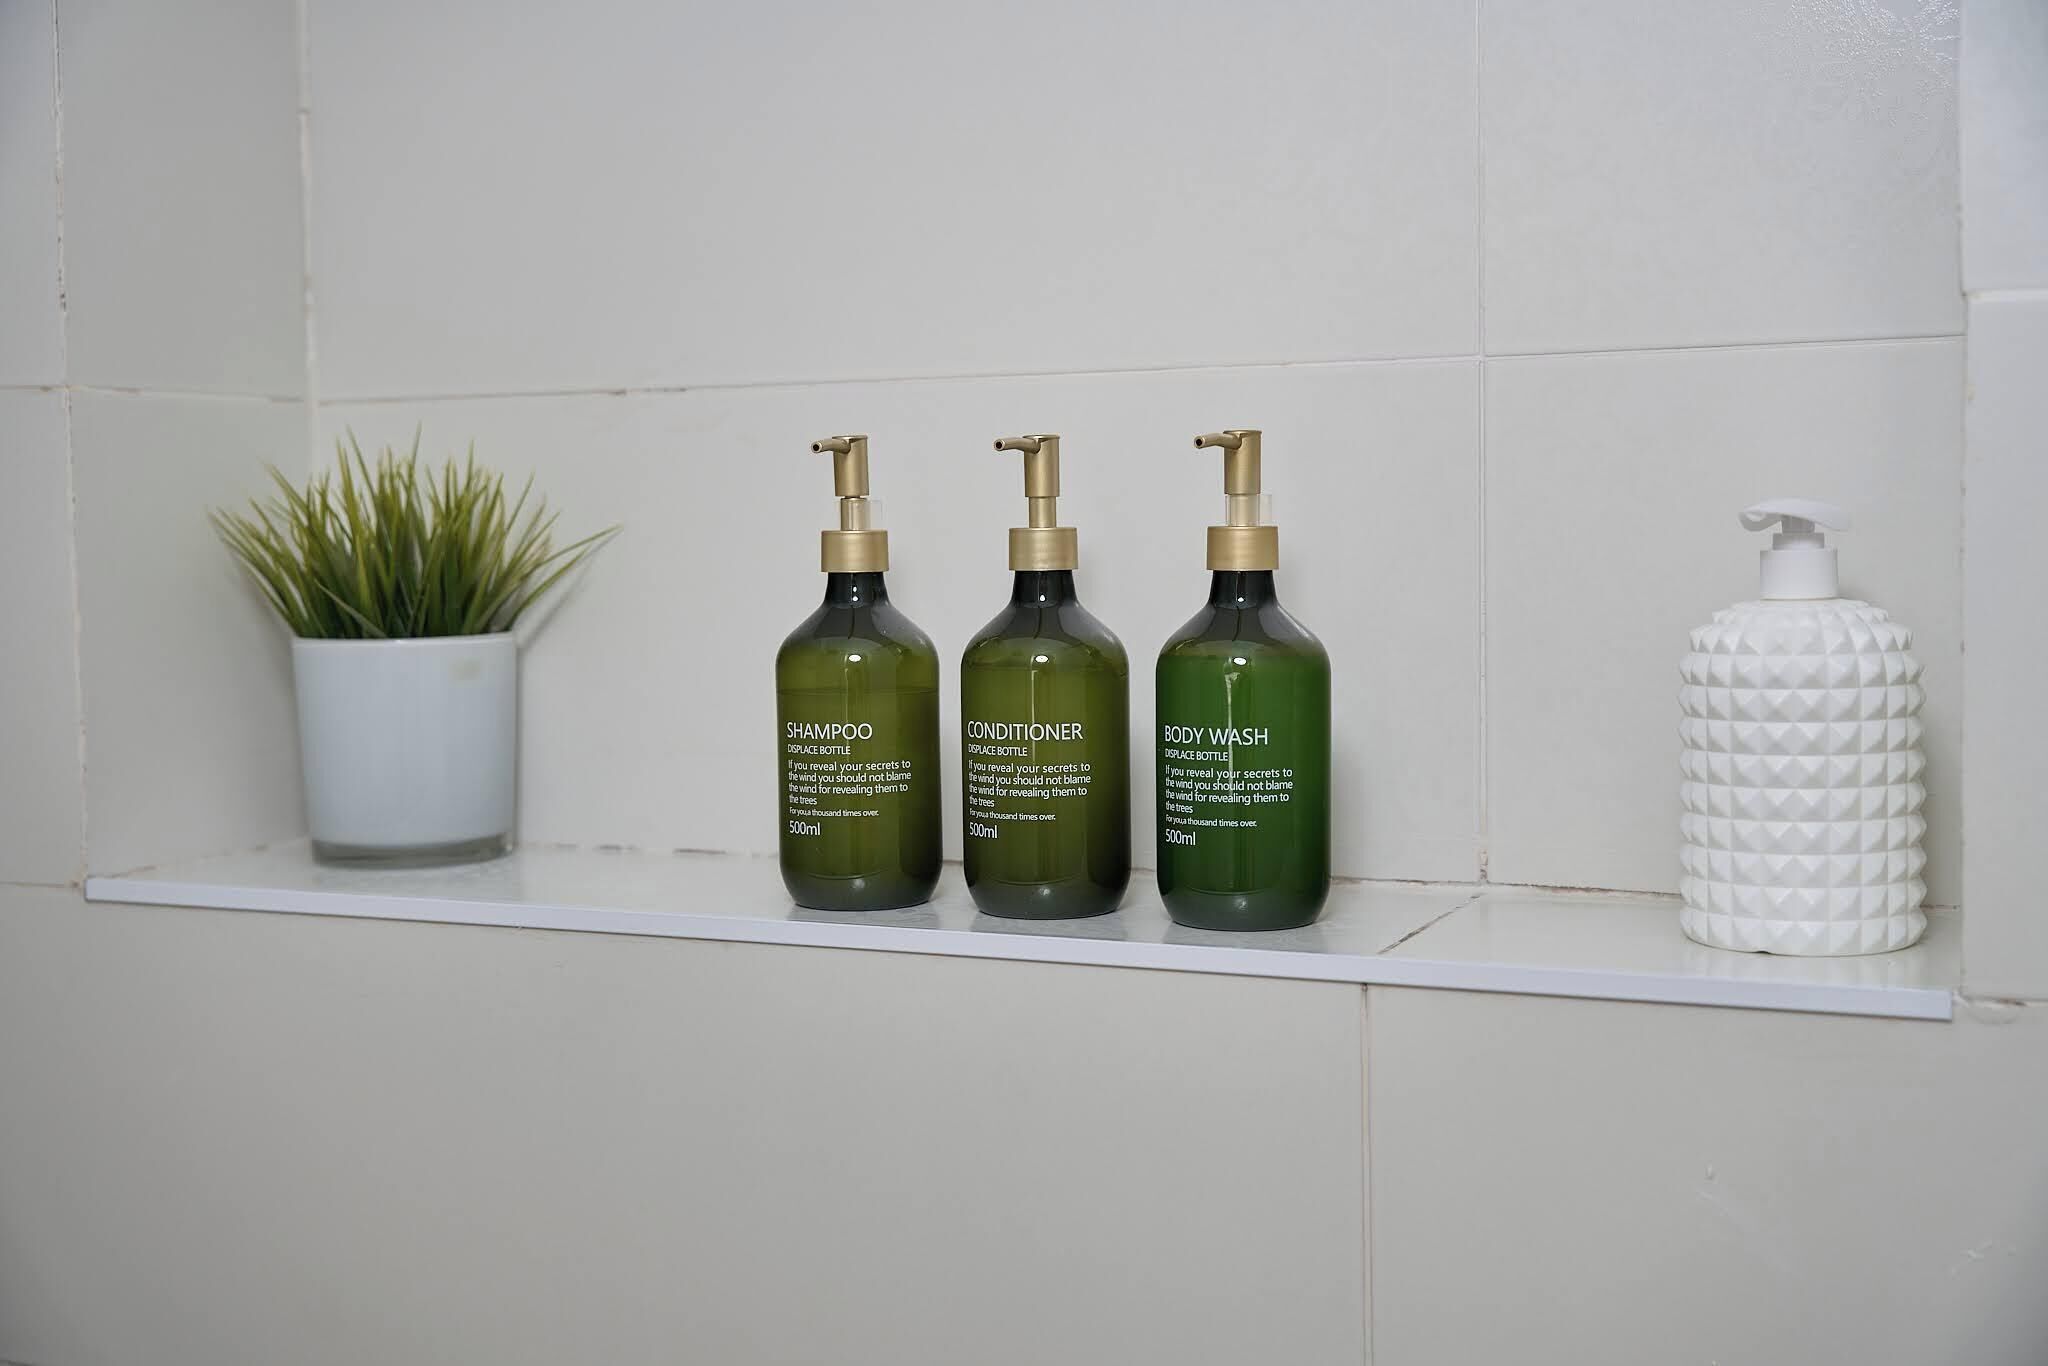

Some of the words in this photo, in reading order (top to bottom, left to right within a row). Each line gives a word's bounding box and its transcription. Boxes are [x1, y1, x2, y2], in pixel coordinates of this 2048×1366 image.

[787, 722, 873, 740] SHAMPOO
[968, 721, 1083, 740] CONDITIONER
[1165, 725, 1204, 745] BODY
[1209, 728, 1268, 745] WASH
[788, 744, 817, 754] DISPLACE
[820, 746, 851, 755] BOTTLE
[968, 744, 996, 755] DISPLACE
[998, 746, 1027, 756] BOTTLE
[1165, 749, 1194, 760] DISPLACE
[1197, 751, 1228, 761] BOTTLE
[788, 760, 793, 768] If
[794, 762, 807, 771] you
[810, 762, 836, 771] reveal
[840, 764, 863, 773] your
[866, 761, 899, 771] secrets
[902, 760, 910, 768] to
[969, 760, 973, 768] If
[974, 762, 986, 772] you
[988, 763, 1013, 772] reveal
[1017, 766, 1039, 775] your
[1043, 763, 1077, 773] secrets
[1081, 763, 1090, 771] to
[1166, 765, 1170, 774] If
[1171, 767, 1184, 777] you
[1187, 768, 1213, 778] reveal
[1217, 771, 1240, 780] your
[1244, 769, 1279, 778] secrets
[1283, 768, 1292, 777] to
[789, 772, 799, 781] the
[799, 773, 816, 782] wind
[818, 775, 834, 784] you
[836, 773, 866, 782] should
[886, 772, 911, 781] blame
[969, 772, 978, 781] the
[978, 774, 994, 783] wind
[996, 776, 1011, 786] you
[1013, 775, 1043, 785] should
[1046, 776, 1062, 784] not
[1064, 775, 1091, 784] blame
[1166, 777, 1176, 787] the
[1176, 779, 1192, 788] wind
[1194, 781, 1210, 791] you
[1213, 780, 1244, 790] should
[1247, 782, 1264, 790] not
[1266, 780, 1293, 790] blame
[789, 783, 799, 792] the
[799, 784, 816, 793] wind
[819, 784, 830, 794] for
[833, 785, 873, 796] revealing
[875, 784, 897, 793] them
[969, 783, 979, 793] the
[979, 785, 994, 796] wind
[996, 787, 1008, 796] for
[1010, 787, 1049, 799] revealing
[1052, 787, 1076, 796] them
[1078, 787, 1087, 795] to
[789, 795, 799, 803] the
[799, 796, 817, 805] trees
[969, 795, 979, 805] the
[979, 797, 994, 807] trees
[1166, 789, 1176, 799] the
[1176, 790, 1193, 801] wind
[1195, 792, 1207, 801] for
[1209, 793, 1250, 805] revealing
[1253, 793, 1278, 802] them
[1280, 793, 1289, 801] to
[812, 809, 841, 817] thousand
[843, 809, 861, 817] times
[1166, 801, 1176, 811] the
[1176, 803, 1193, 813] trees
[989, 811, 1017, 820] thousand
[1188, 817, 1217, 826] thousand
[1219, 819, 1238, 827] times
[789, 821, 820, 835] 500ml
[970, 822, 997, 838] 500ml
[1165, 829, 1196, 845] 500ml
